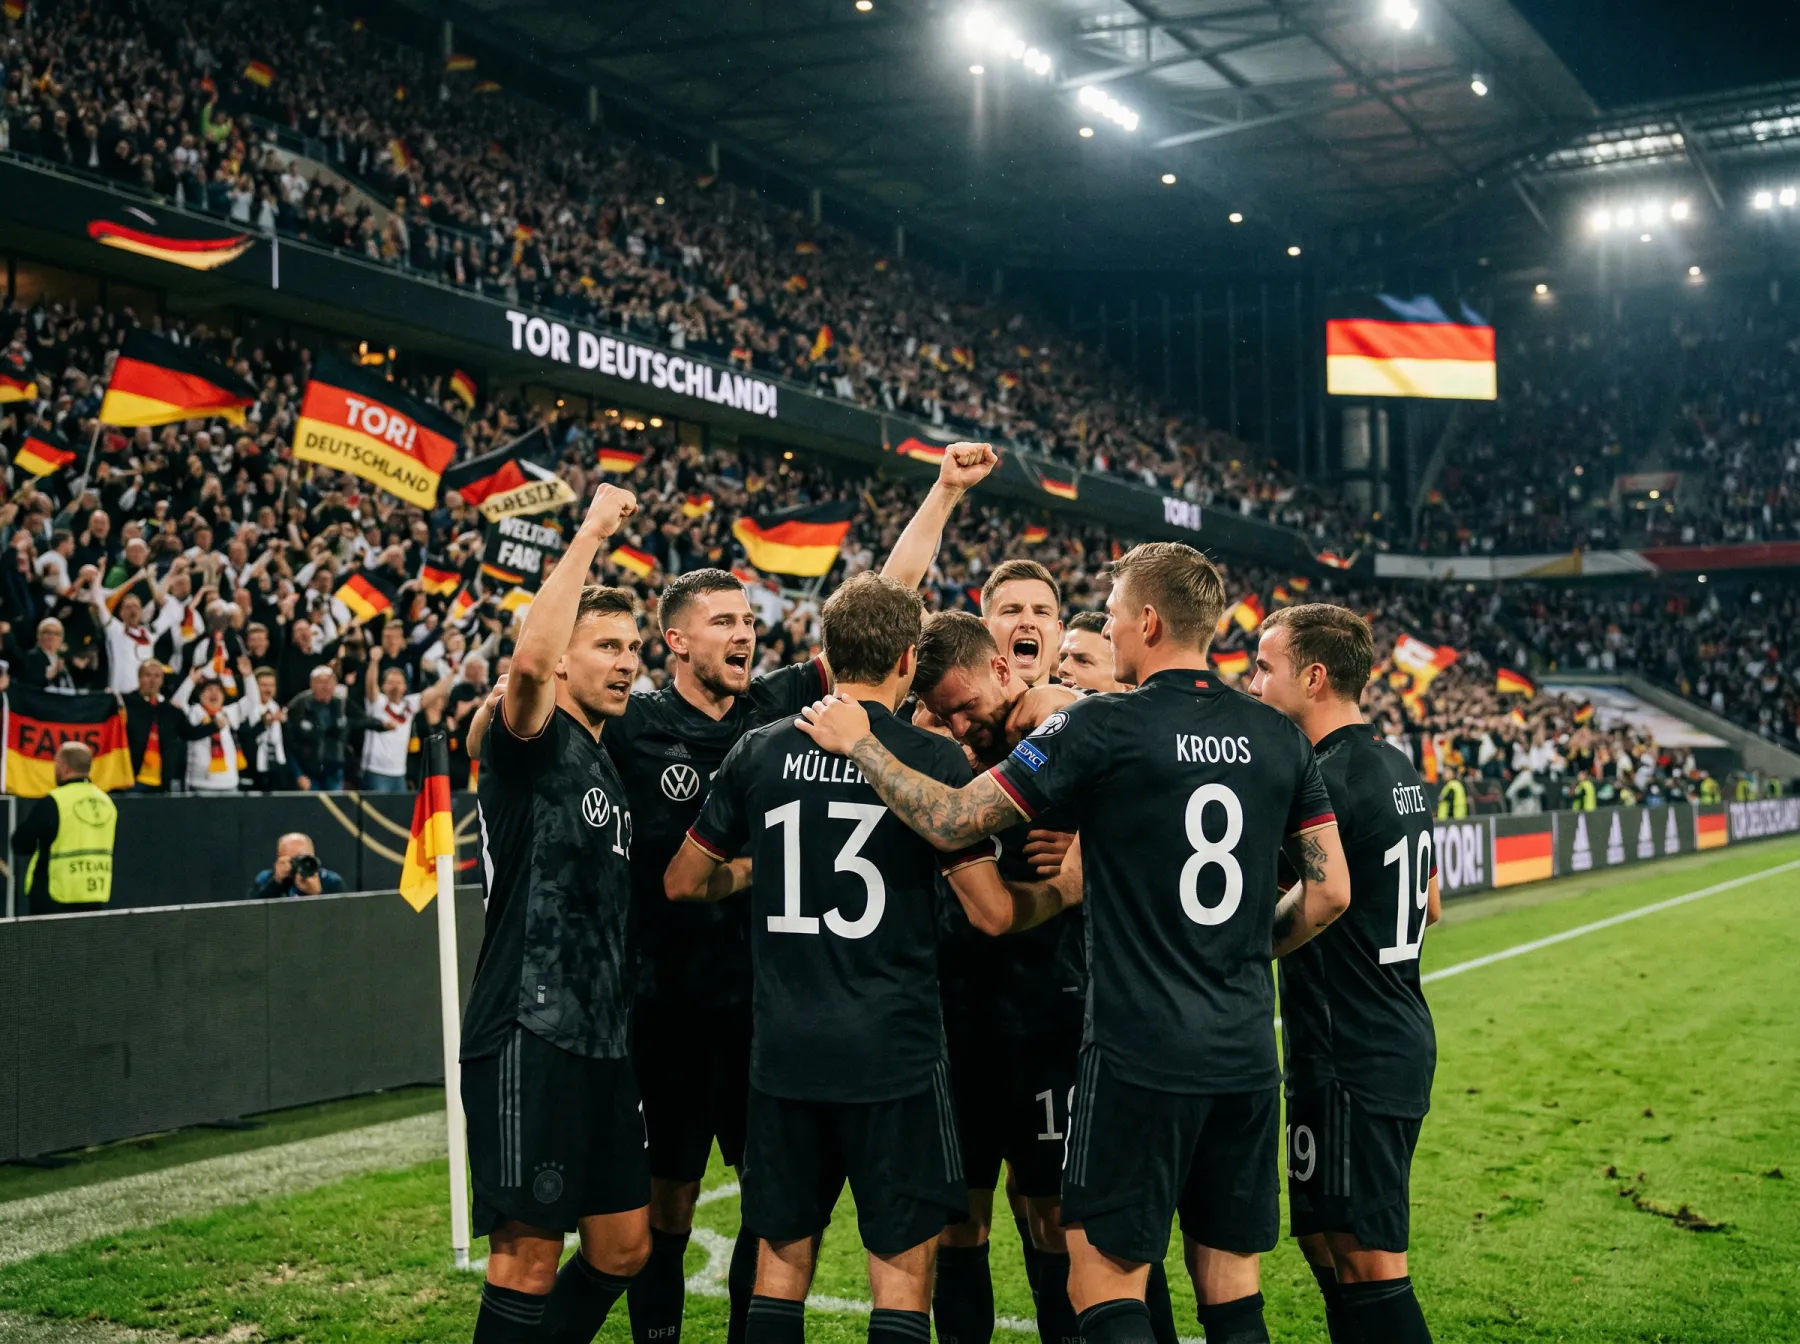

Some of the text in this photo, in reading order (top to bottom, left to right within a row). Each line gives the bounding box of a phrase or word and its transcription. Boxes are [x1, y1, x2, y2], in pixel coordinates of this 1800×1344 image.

[506, 309, 778, 419] TOR DEUTSCHLAND!
[345, 397, 418, 451] TOR!
[304, 432, 430, 493] DEUTSCHLAND
[1175, 733, 1252, 764] KROOS
[1392, 781, 1427, 816] GÖTZE
[764, 799, 889, 939] 13
[1179, 782, 1244, 926] 8
[1433, 822, 1484, 891] TOR!
[1379, 829, 1432, 965] 19
[1035, 1085, 1076, 1171] 1
[1286, 1123, 1316, 1182] 19
[648, 1325, 676, 1339] DFB
